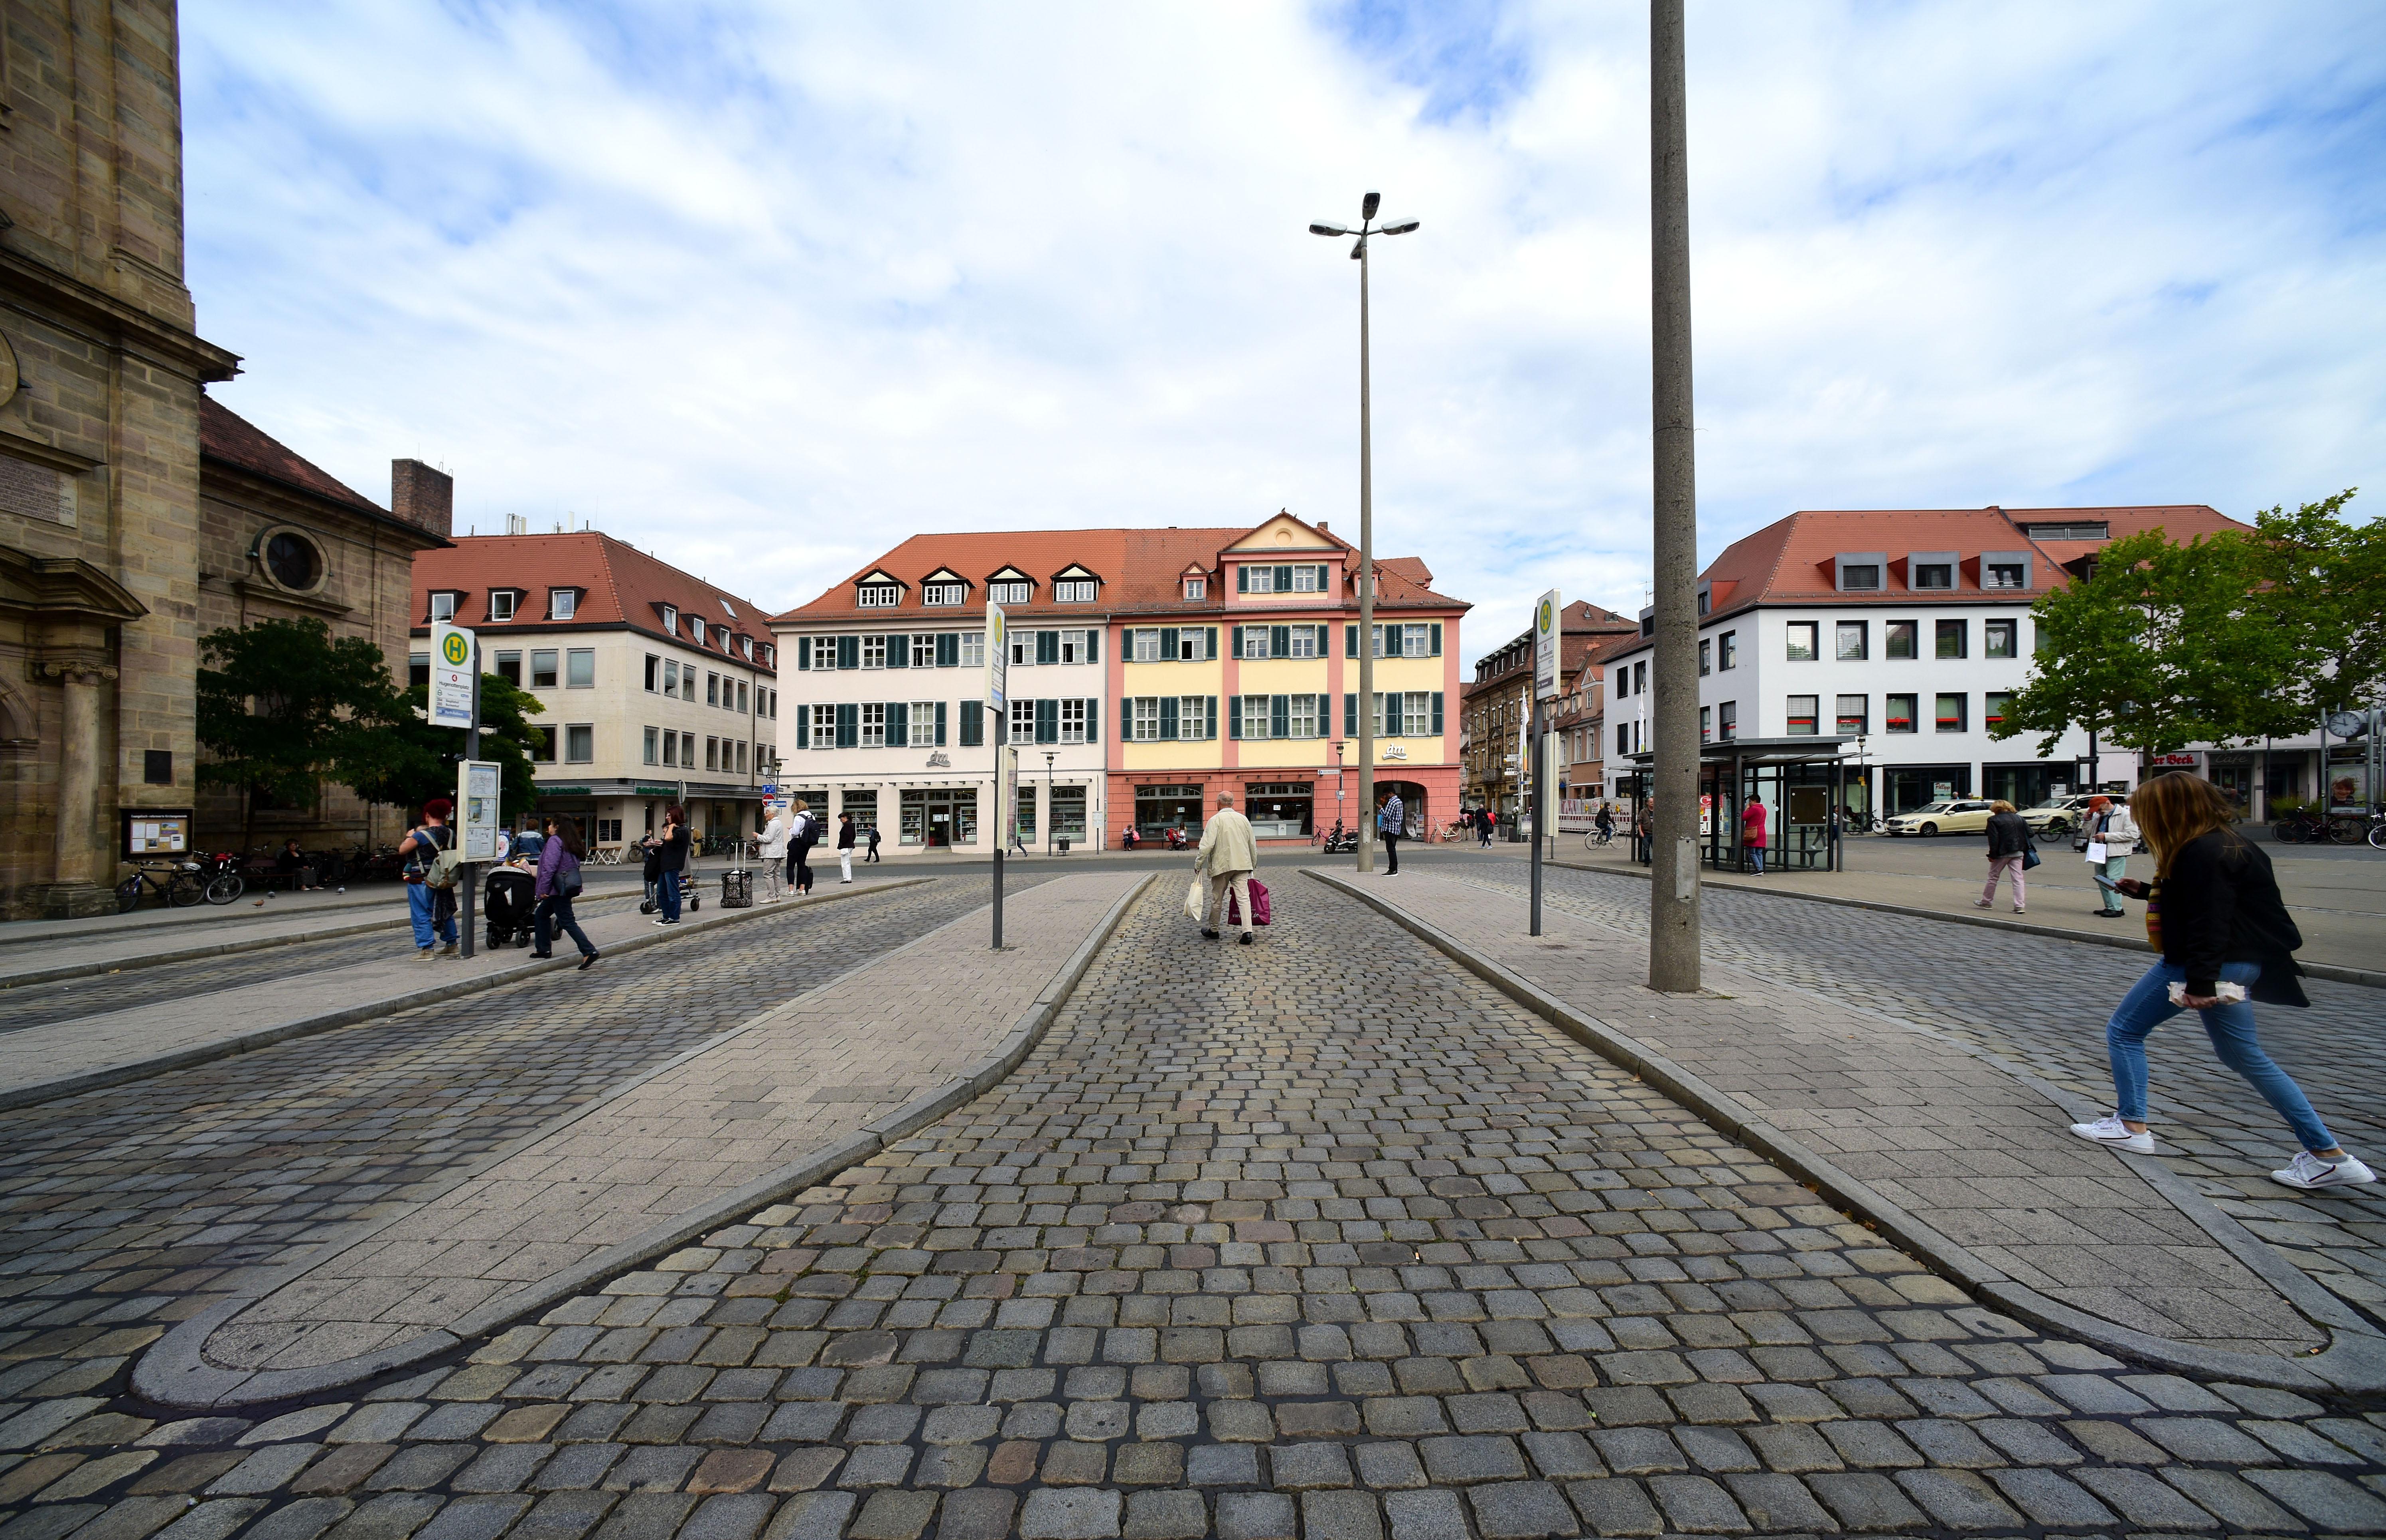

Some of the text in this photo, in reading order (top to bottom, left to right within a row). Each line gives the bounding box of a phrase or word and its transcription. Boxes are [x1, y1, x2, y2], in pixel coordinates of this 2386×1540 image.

[450, 639, 462, 658] H
[439, 681, 470, 690] Hugenottenplatz
[1386, 743, 1404, 754] dm
[930, 750, 948, 761] dm
[2166, 754, 2194, 765] Beck
